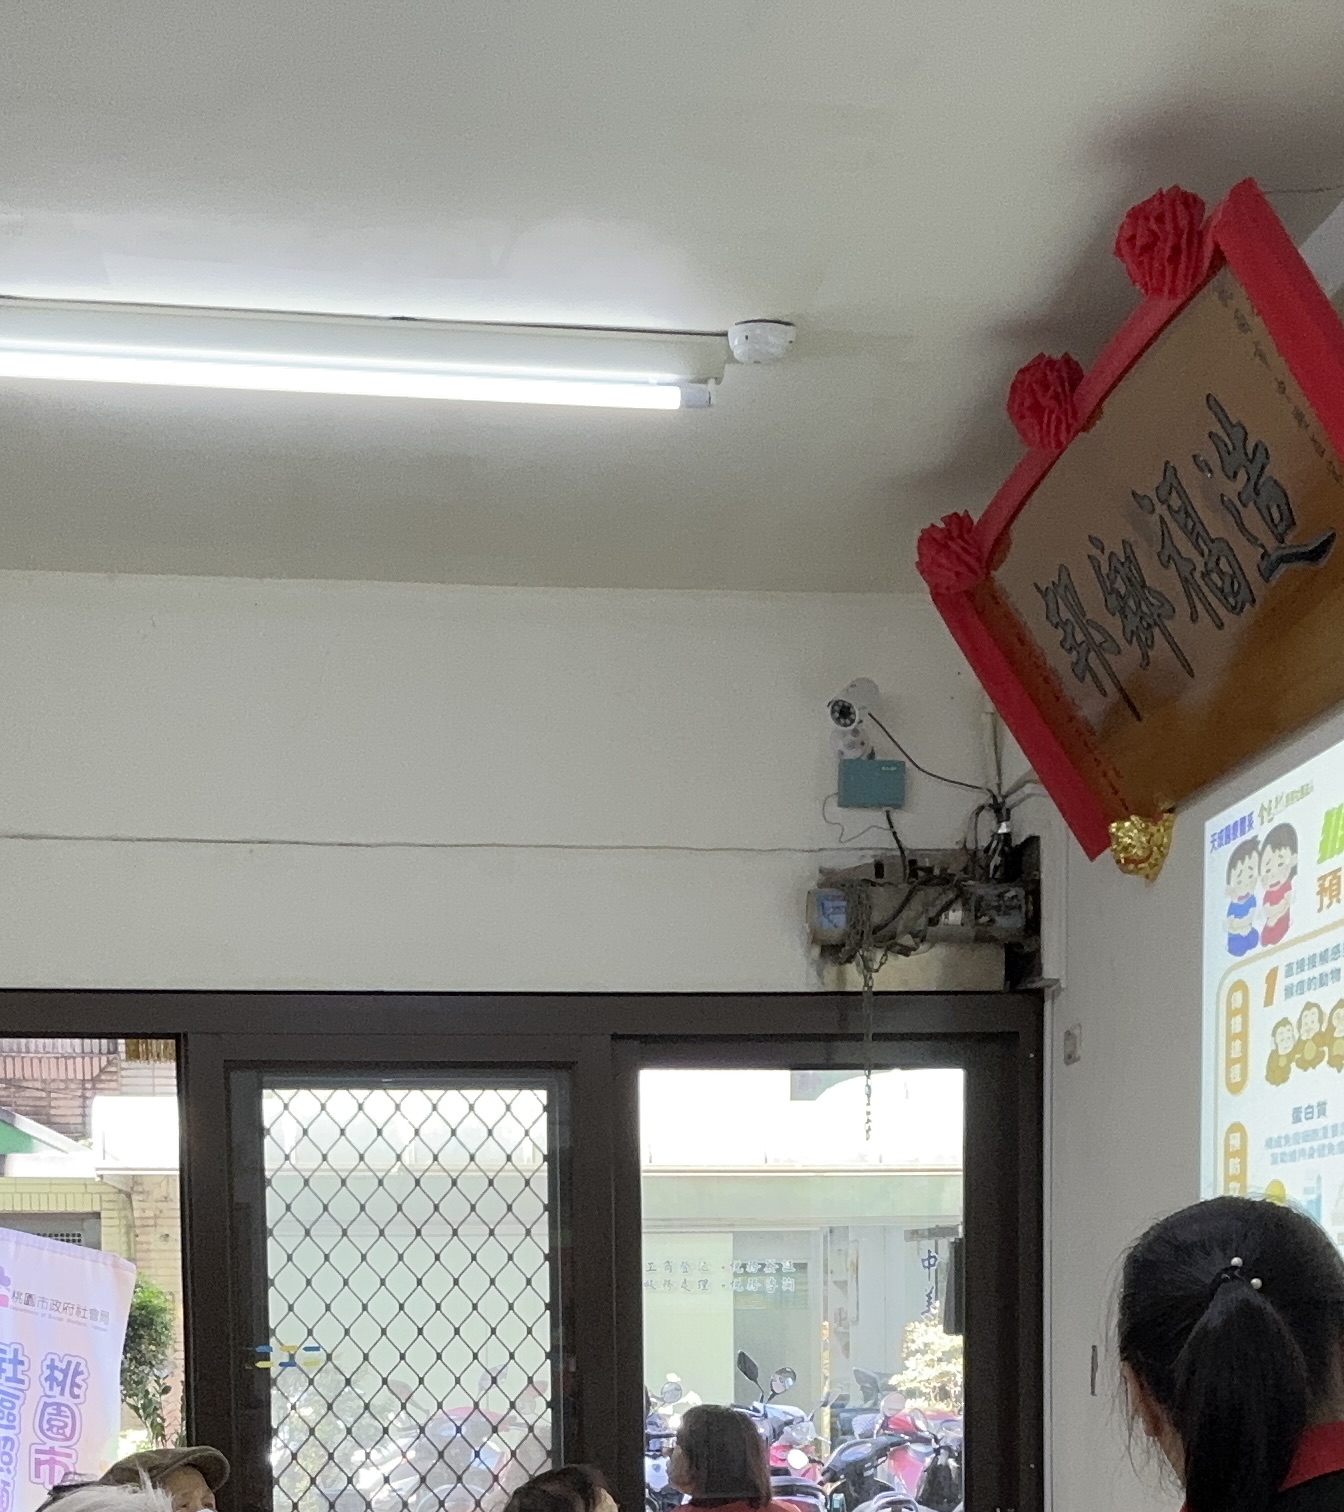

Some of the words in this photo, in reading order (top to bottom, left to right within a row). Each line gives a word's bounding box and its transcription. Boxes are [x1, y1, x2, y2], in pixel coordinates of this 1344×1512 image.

[1264, 966, 1279, 1008] 1
[1292, 1099, 1328, 1124] 蛋白質
[12, 1289, 110, 1325] 桃園市政府社會局
[31, 1354, 87, 1487] 桃園市
